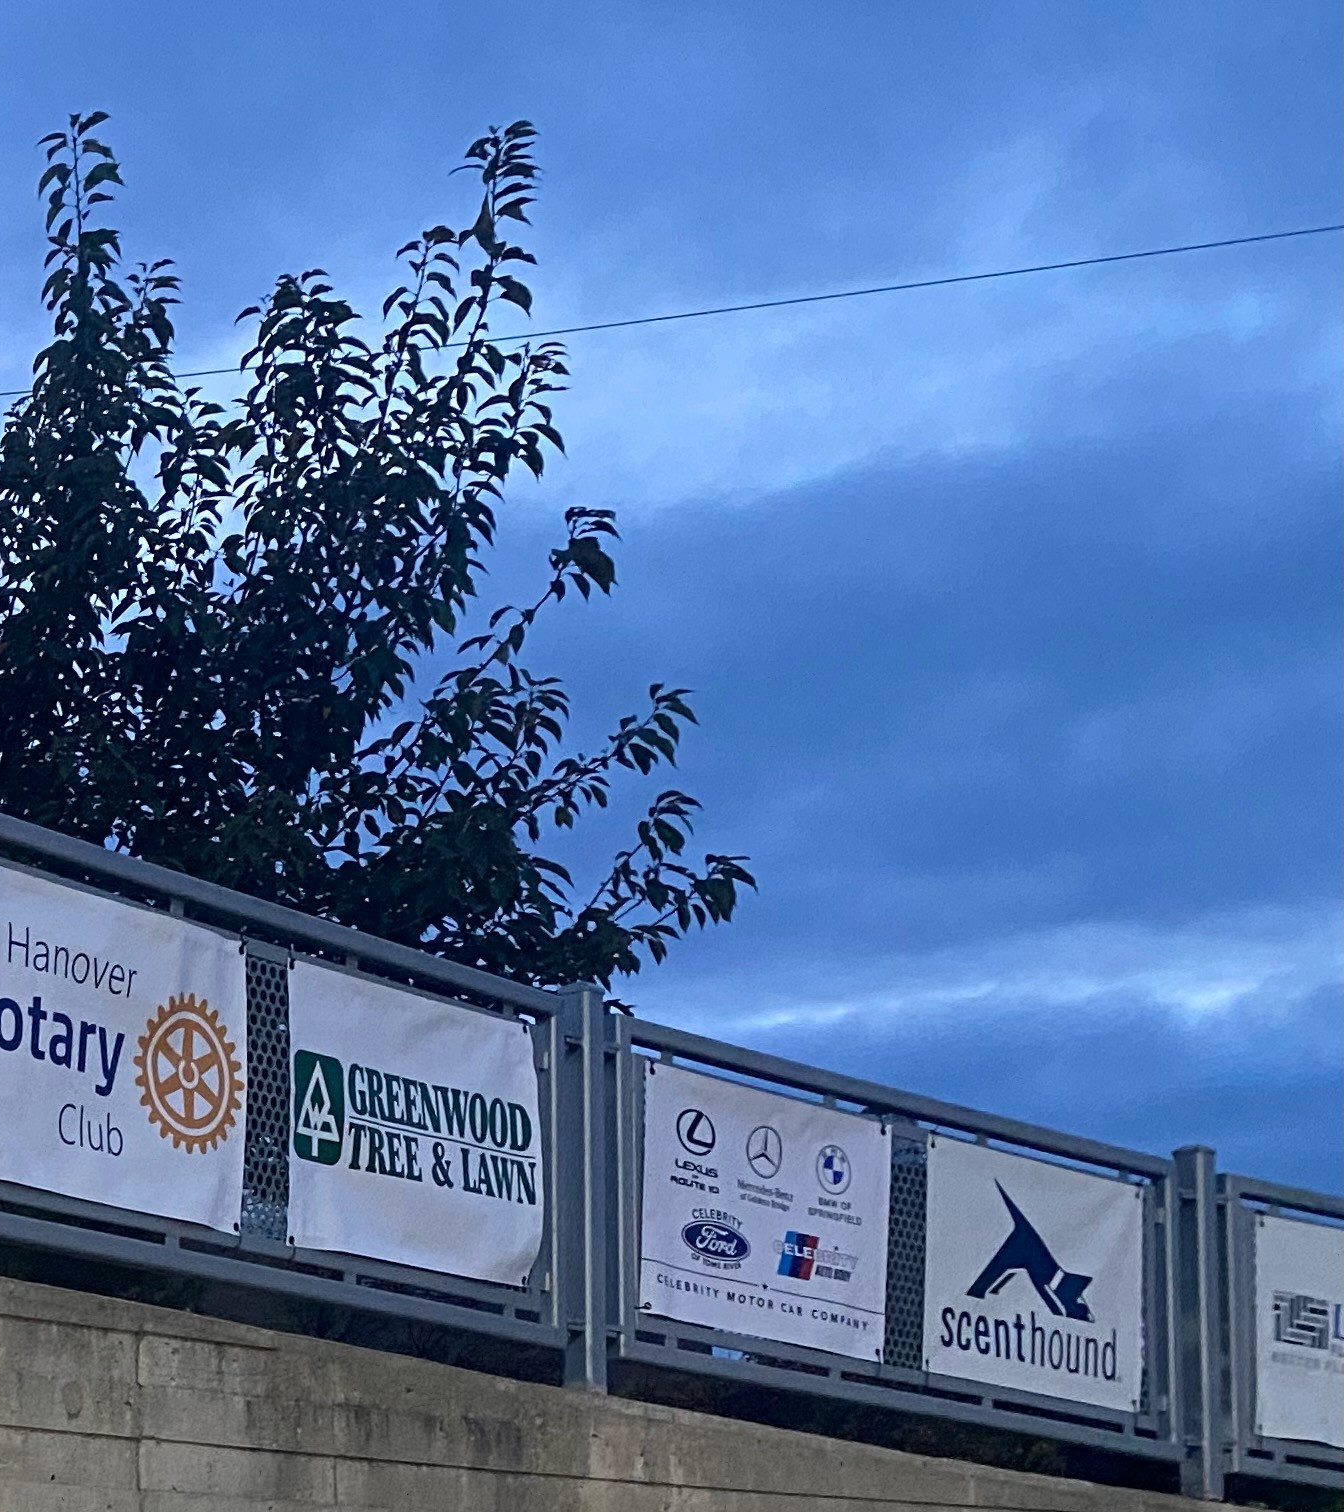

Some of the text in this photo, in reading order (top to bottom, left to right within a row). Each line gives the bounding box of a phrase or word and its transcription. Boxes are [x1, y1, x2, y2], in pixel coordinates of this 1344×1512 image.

[7, 921, 138, 999] Hanover
[58, 1102, 124, 1157] Club
[348, 1063, 533, 1152] GREENWOOD
[348, 1121, 537, 1206] TREE & LAWN
[670, 1175, 706, 1191] ROUTE
[708, 1185, 720, 1194] 10
[674, 1157, 719, 1178] LEXUS
[691, 1207, 743, 1230] CELEBRITY
[696, 1225, 738, 1256] Ford
[656, 1273, 870, 1332] CELEBRITY MOTOR CAR COMPANY
[940, 1306, 1117, 1381] scenthound
